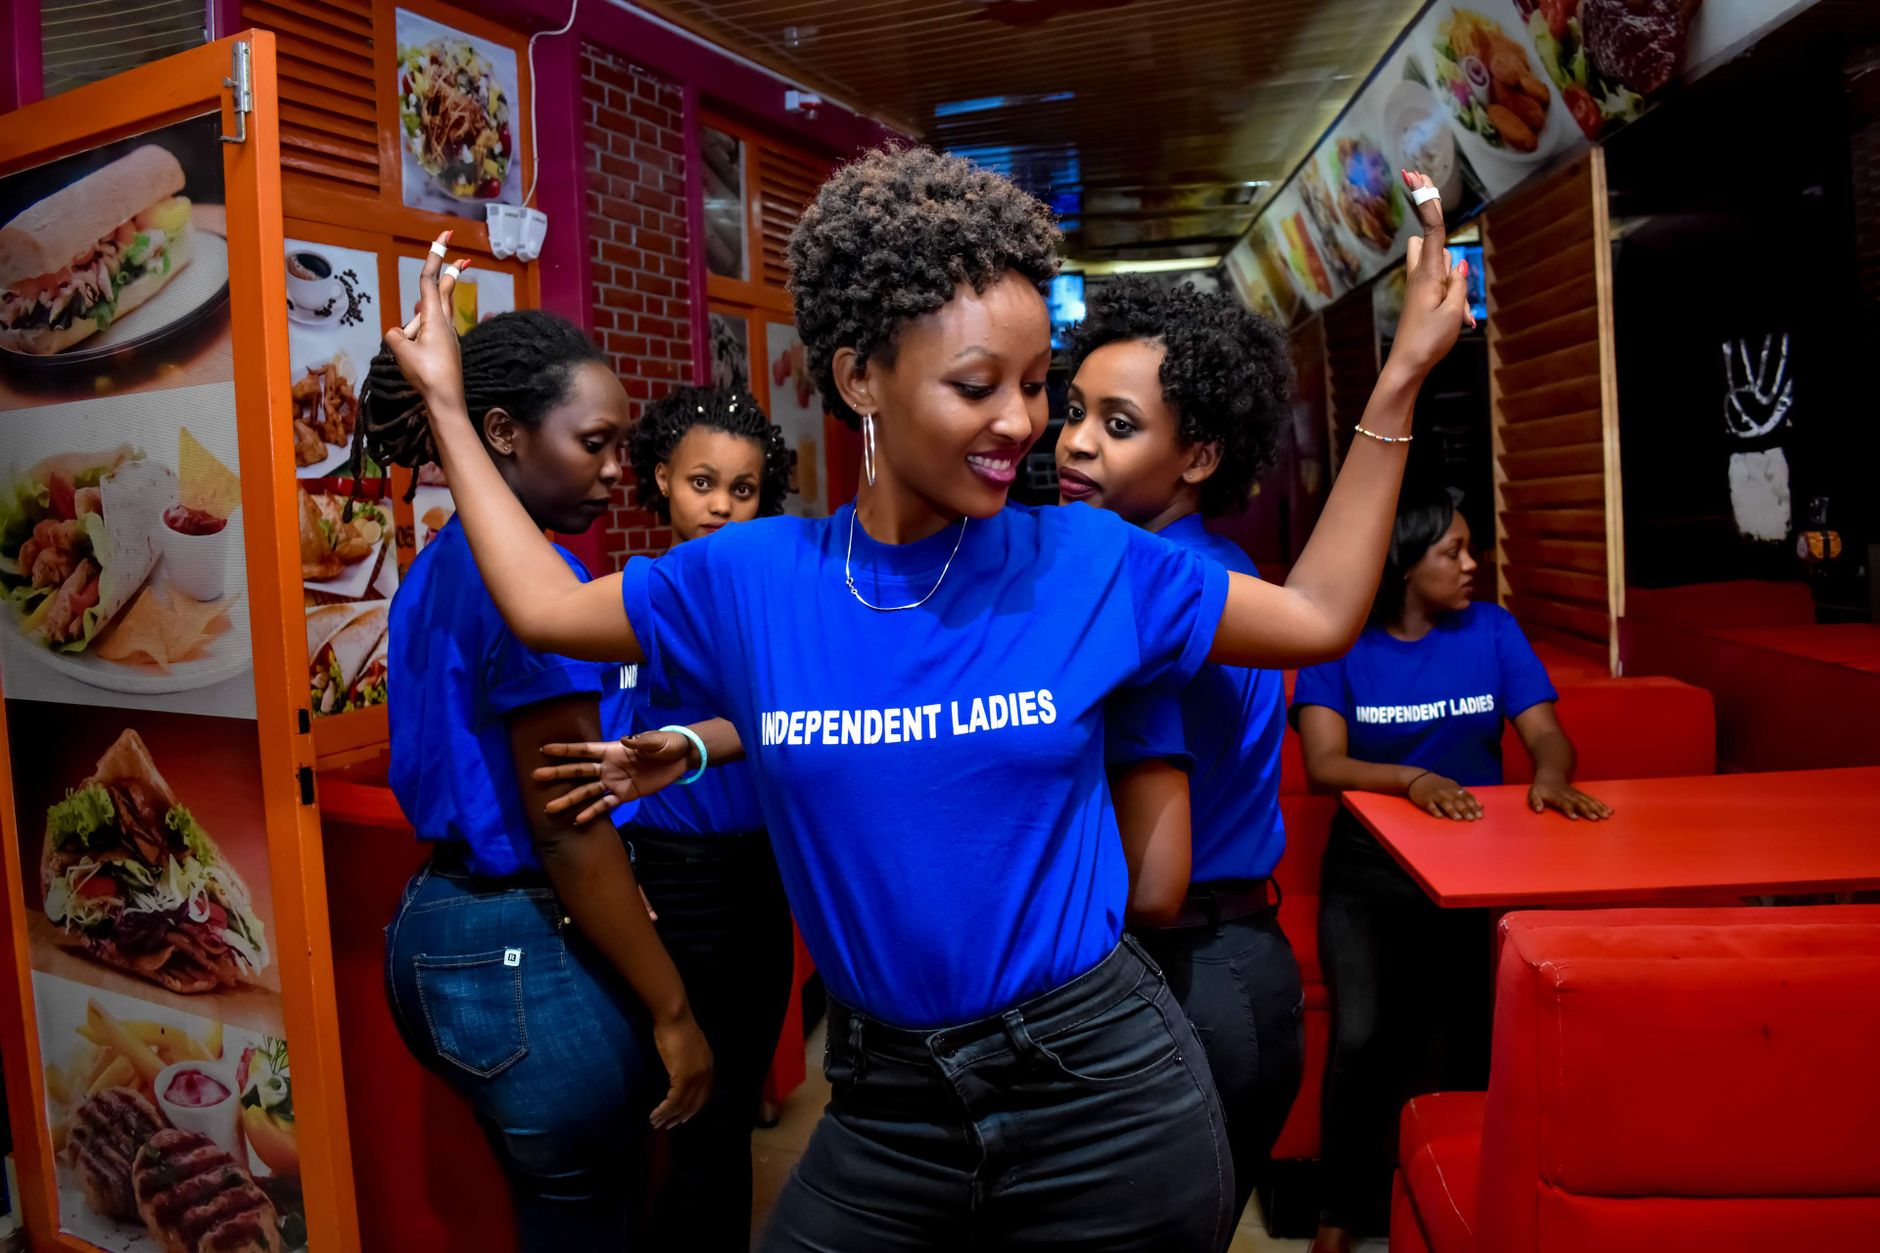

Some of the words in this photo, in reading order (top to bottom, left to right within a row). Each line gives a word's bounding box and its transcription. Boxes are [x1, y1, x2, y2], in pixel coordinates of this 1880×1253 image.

[761, 703, 942, 746] INDEPENDENT
[951, 689, 1057, 735] LADIES
[1356, 701, 1446, 724] INDEPENDENT
[1450, 694, 1495, 716] LADIES
